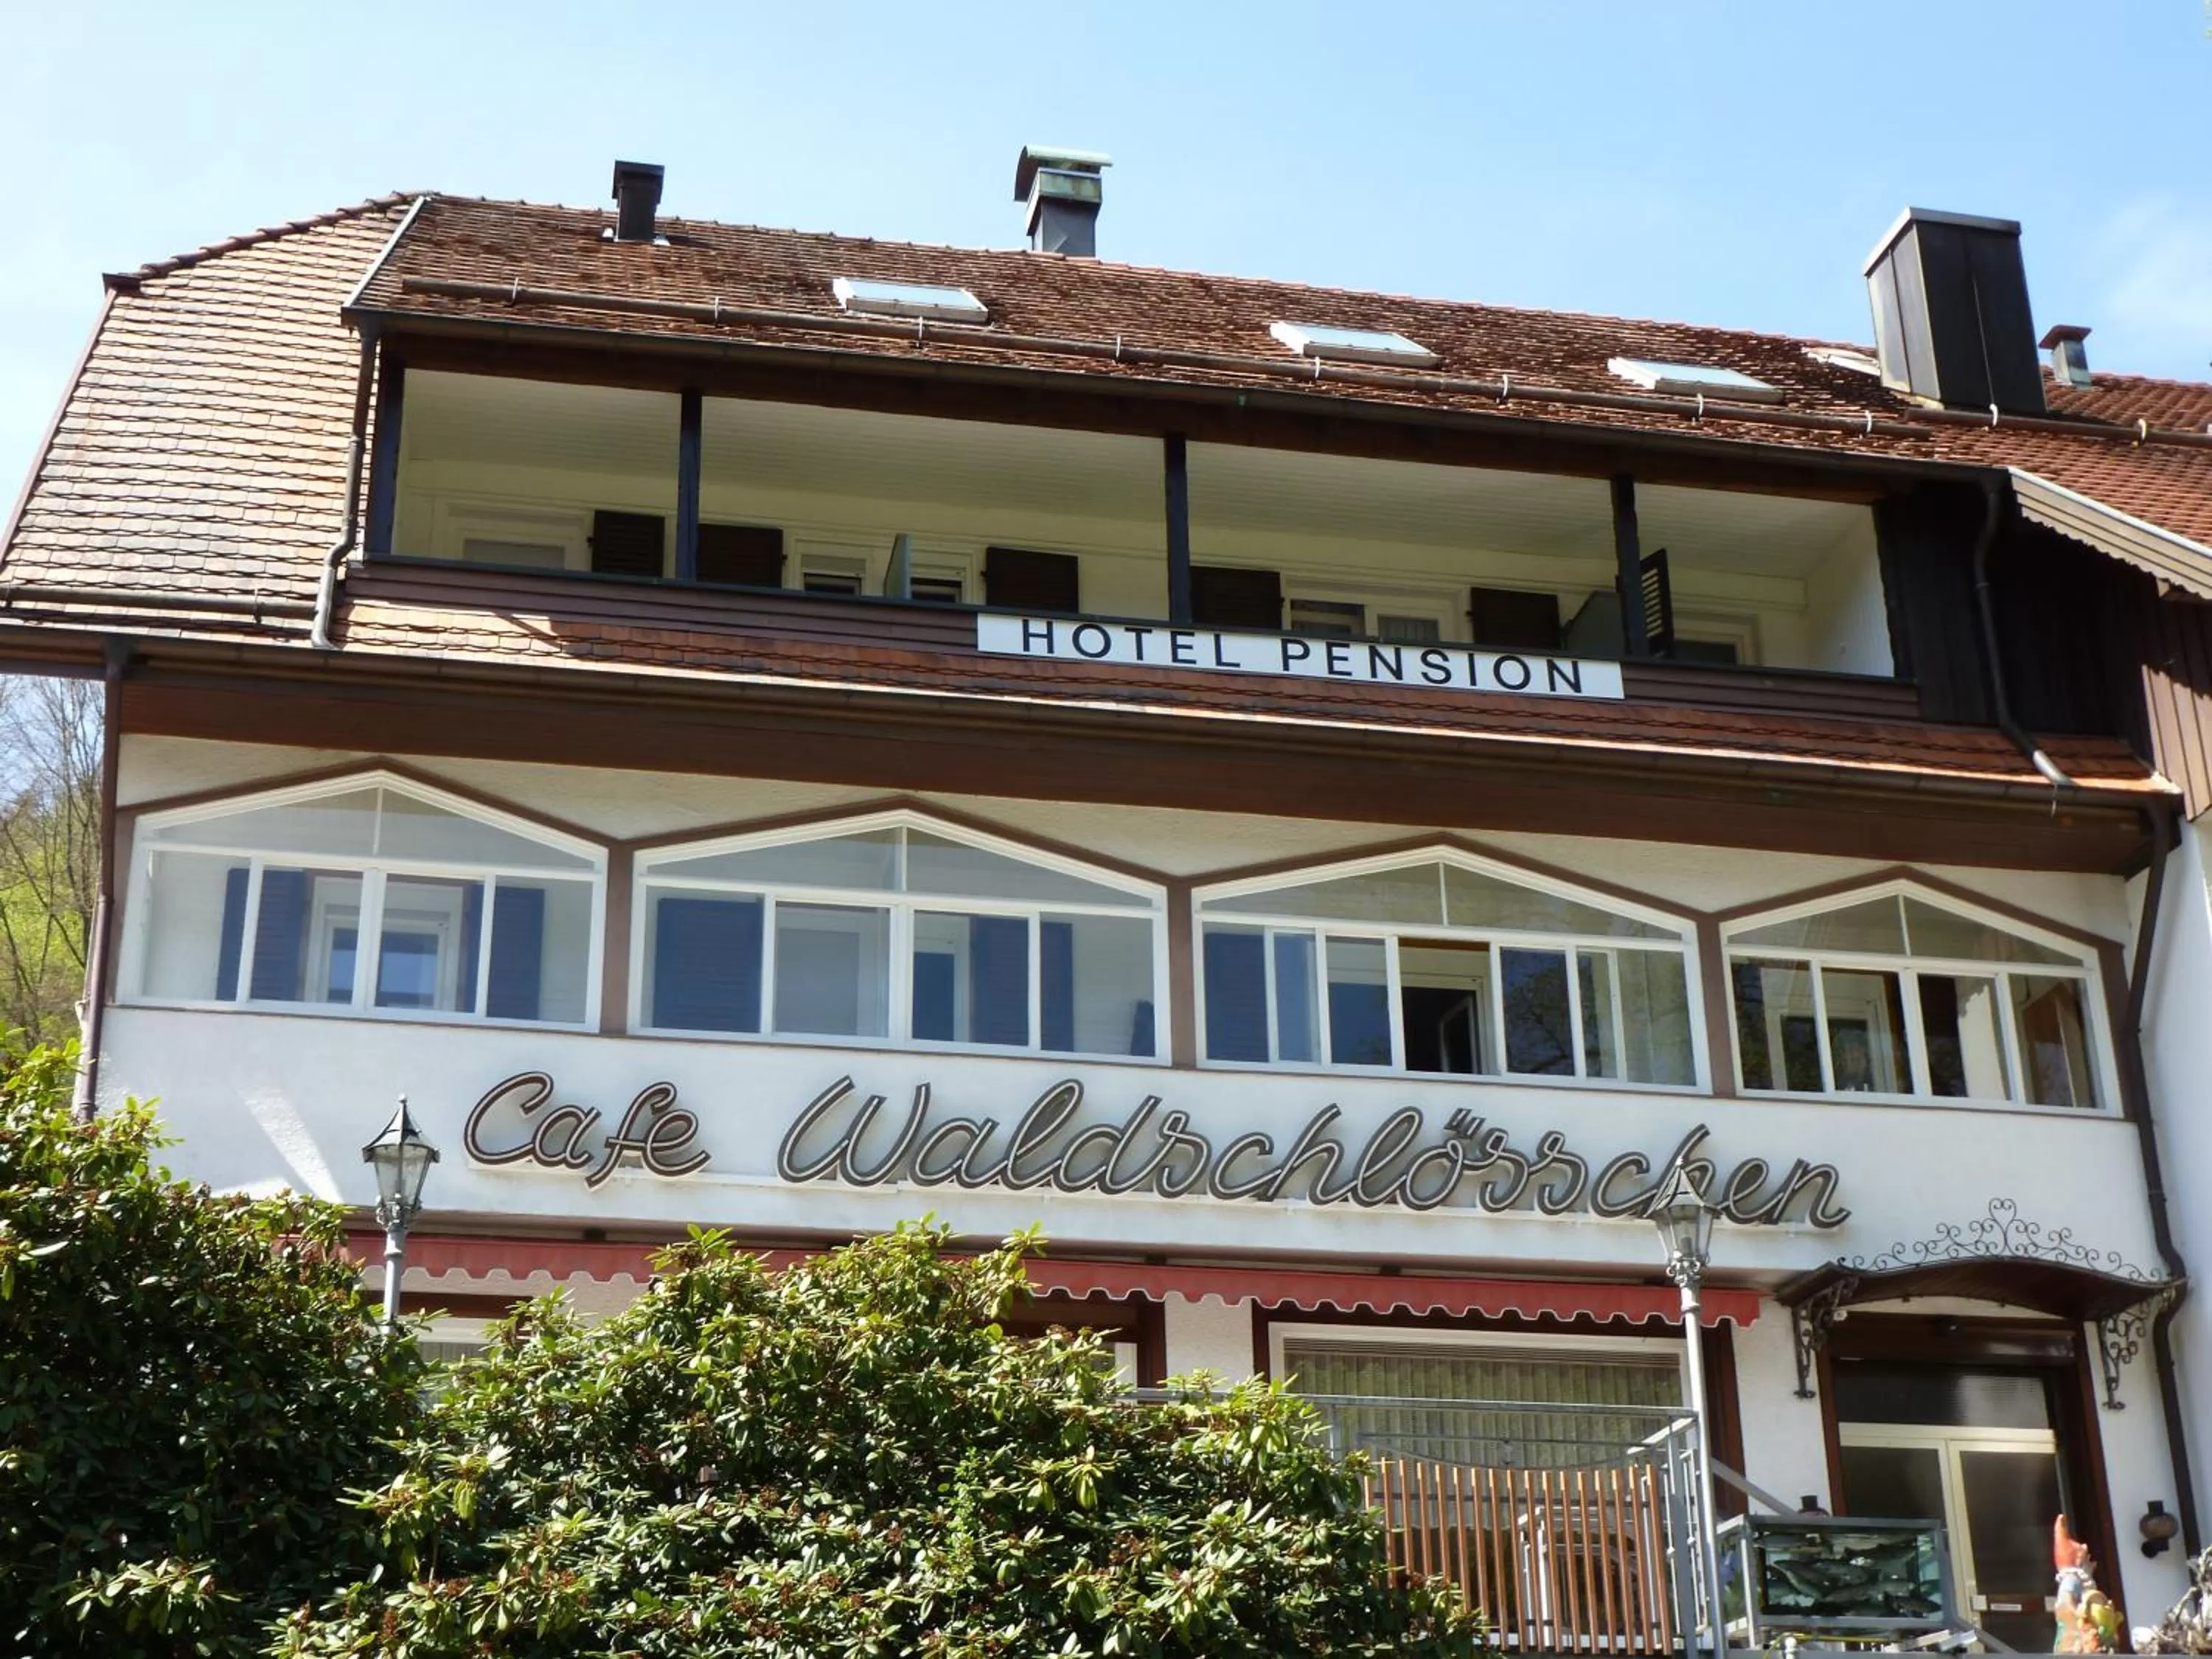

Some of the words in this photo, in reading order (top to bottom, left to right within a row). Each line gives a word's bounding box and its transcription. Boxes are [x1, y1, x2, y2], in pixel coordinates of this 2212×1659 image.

[1022, 619, 1241, 667] HOTEL
[1282, 639, 1582, 694] PENSION
[465, 1071, 712, 1189] Cafe
[776, 1075, 1851, 1228] Waldschlösschen
